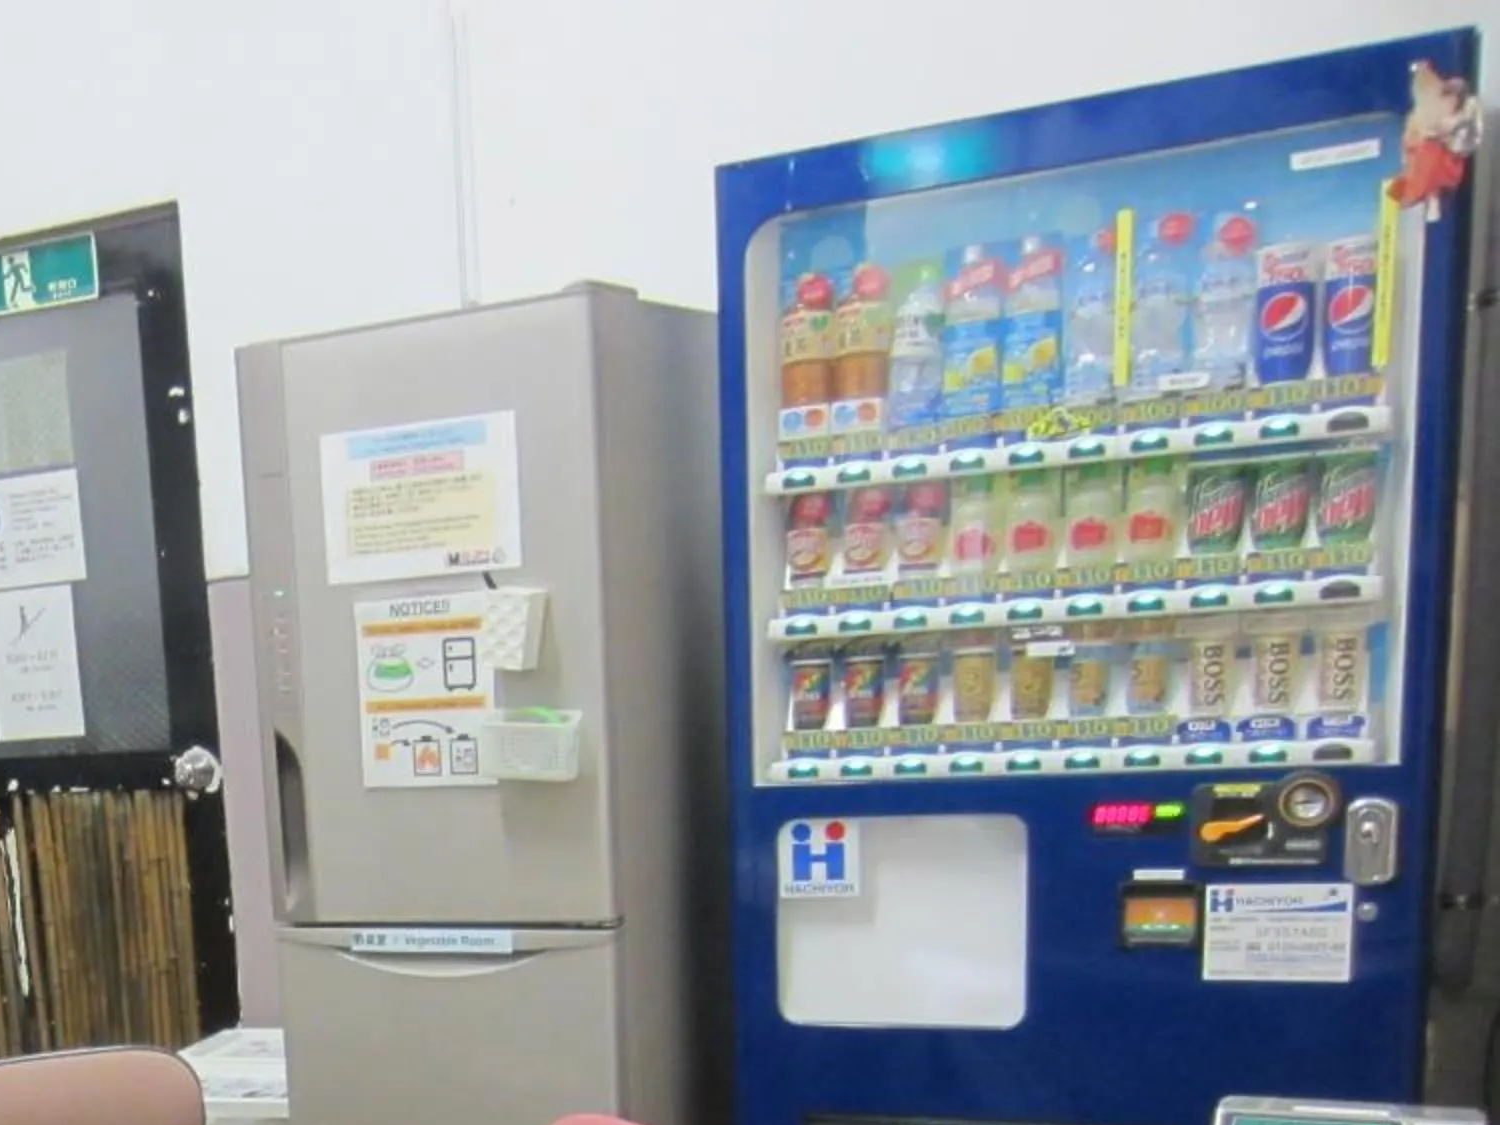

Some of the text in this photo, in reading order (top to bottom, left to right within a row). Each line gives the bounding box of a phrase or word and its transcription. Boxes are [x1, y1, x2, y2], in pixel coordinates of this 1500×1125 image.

[1203, 643, 1225, 707] BOSS
[1268, 641, 1290, 704] BOSS
[1332, 636, 1357, 700] BOSS
